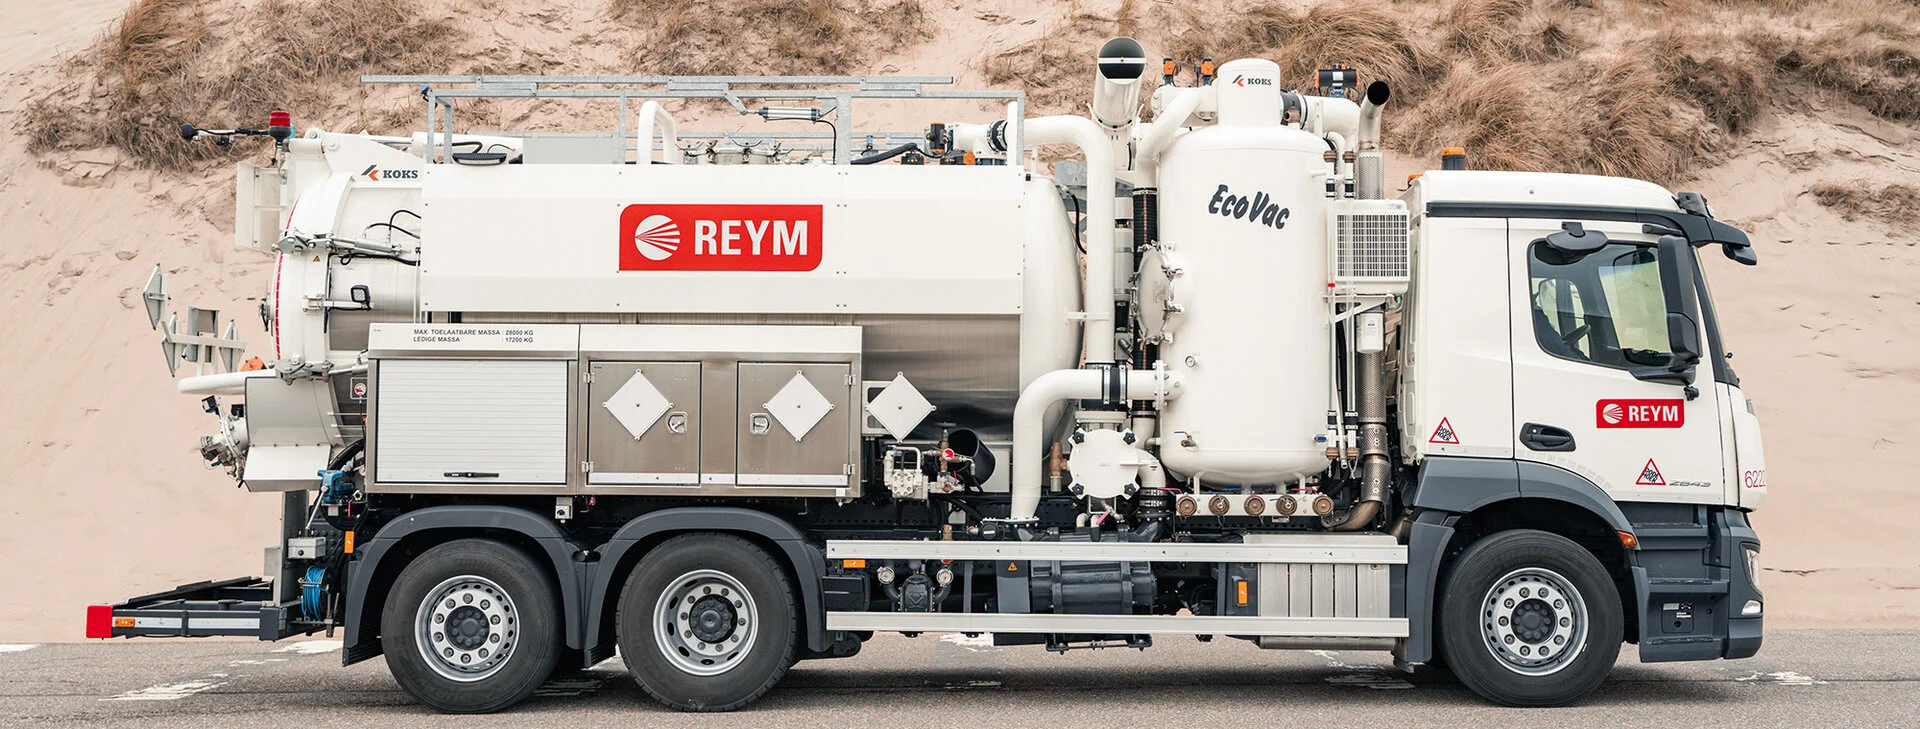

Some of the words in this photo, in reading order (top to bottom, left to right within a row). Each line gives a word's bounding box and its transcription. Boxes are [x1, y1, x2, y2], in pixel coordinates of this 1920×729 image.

[1247, 78, 1272, 86] KOKS
[383, 169, 418, 179] KOKS
[1208, 184, 1290, 230] EcoVac
[694, 219, 808, 256] REYM
[1628, 405, 1679, 422] REYM
